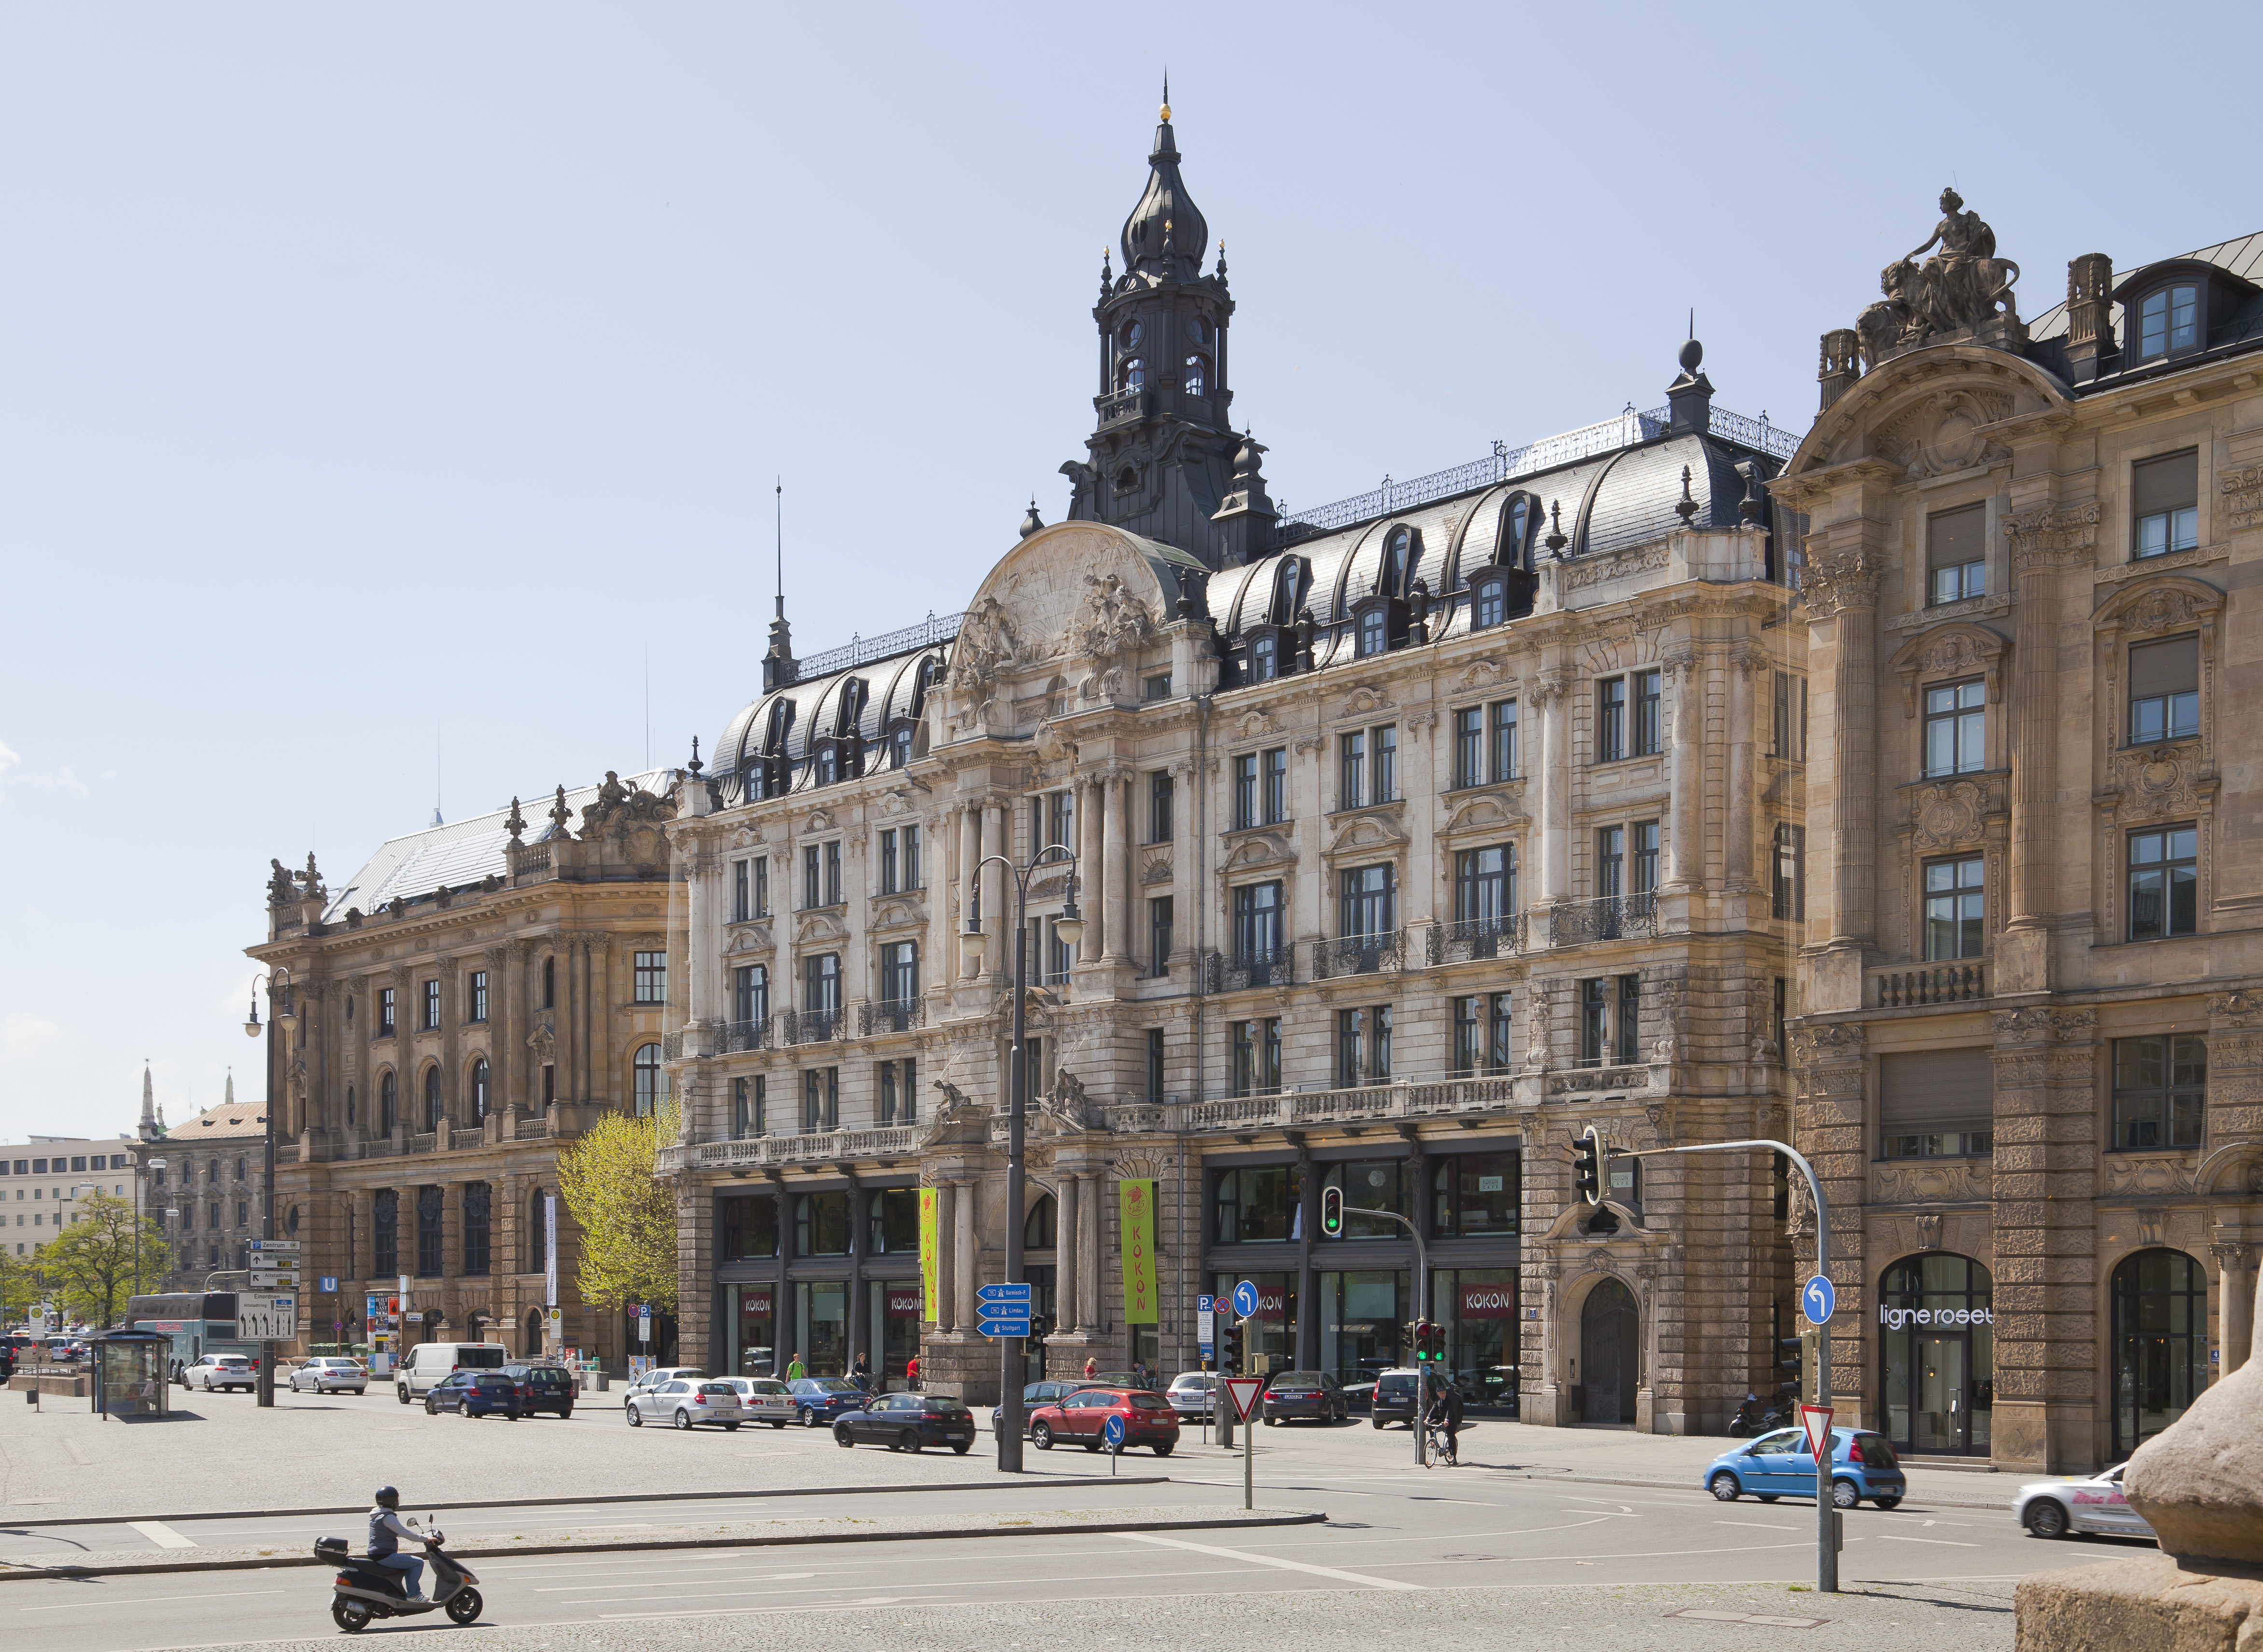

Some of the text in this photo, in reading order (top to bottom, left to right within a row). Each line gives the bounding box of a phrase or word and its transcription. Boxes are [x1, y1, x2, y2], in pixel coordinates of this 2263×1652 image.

[1137, 1200, 1145, 1208] 25
[550, 1260, 554, 1268] in
[926, 1231, 936, 1309] KOKON
[1133, 1225, 1145, 1311] KOKON
[325, 1278, 335, 1291] U
[746, 1299, 770, 1311] KOKON
[892, 1297, 920, 1310] KOKON
[1200, 1297, 1208, 1310] P
[1257, 1296, 1282, 1310] KON
[1467, 1293, 1509, 1308] KOKON
[641, 1306, 647, 1316] P
[1880, 1304, 1993, 1330] ligne roset
